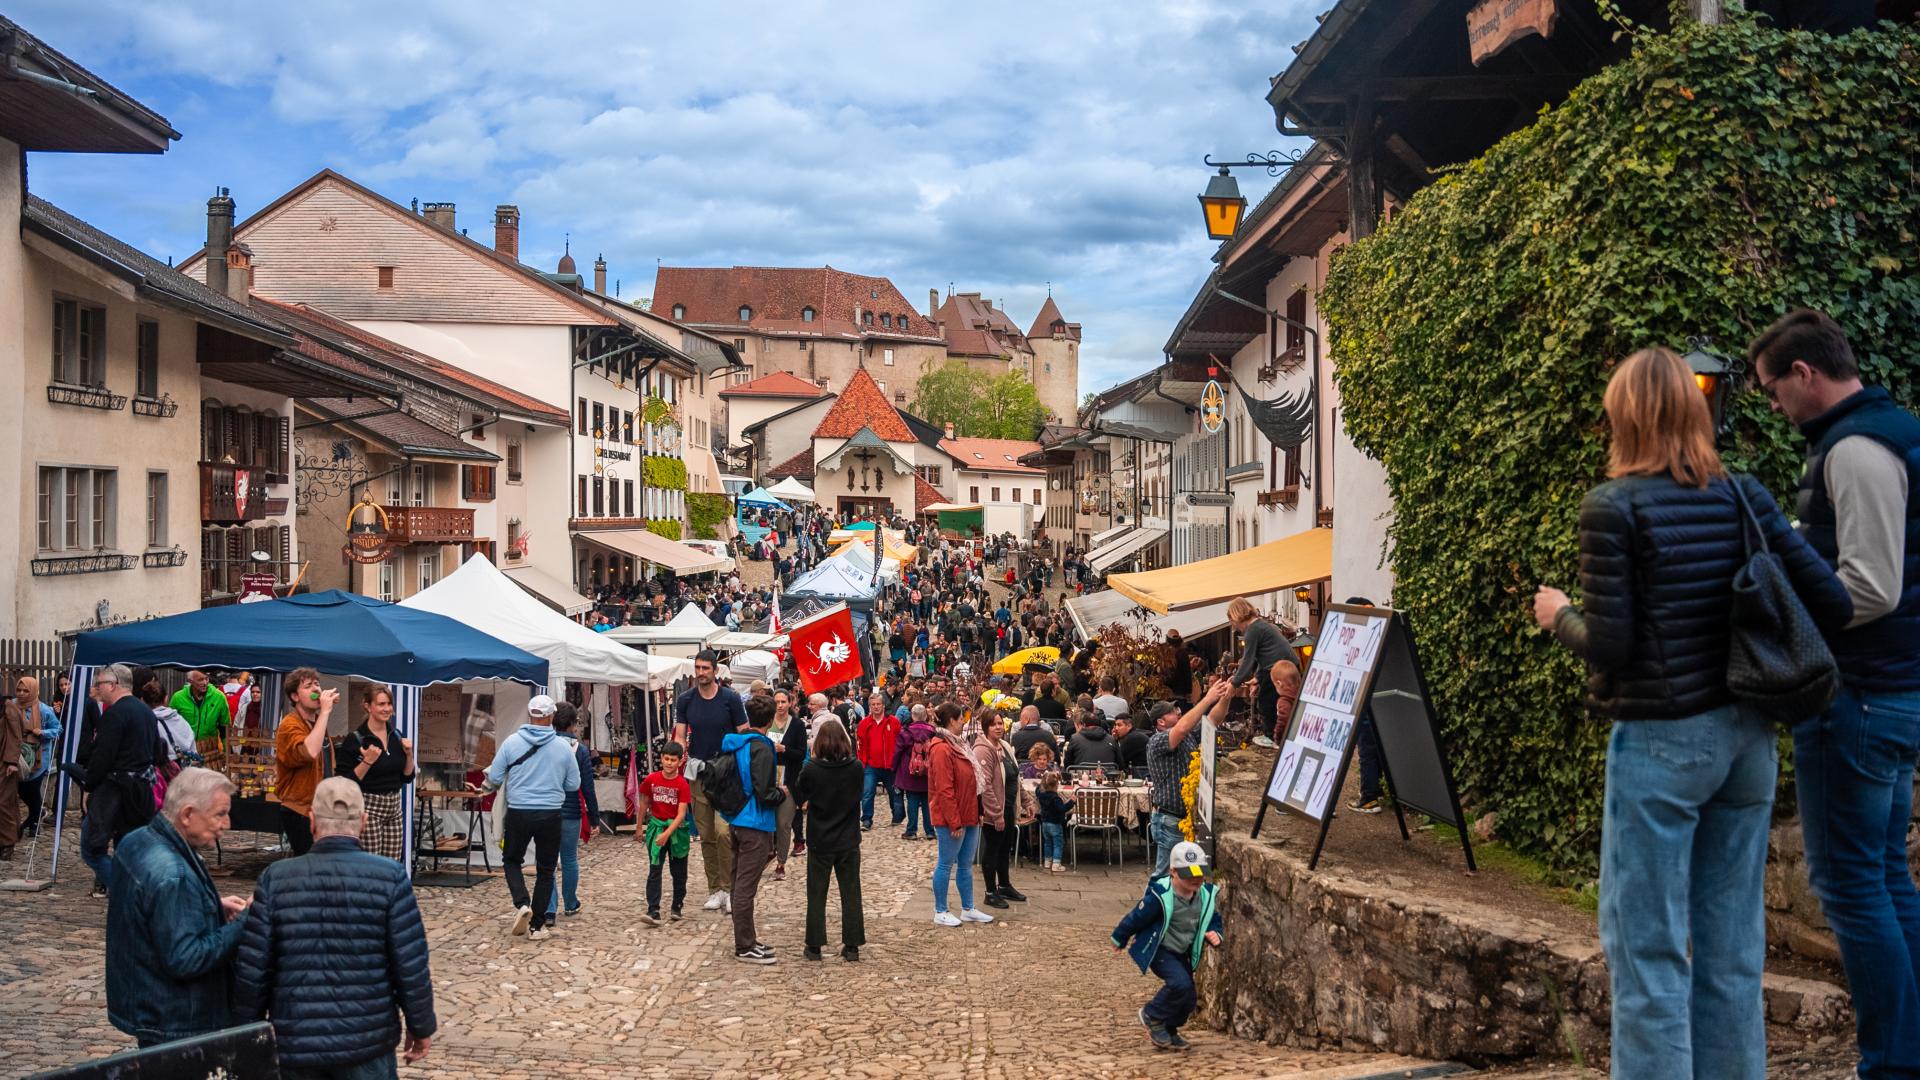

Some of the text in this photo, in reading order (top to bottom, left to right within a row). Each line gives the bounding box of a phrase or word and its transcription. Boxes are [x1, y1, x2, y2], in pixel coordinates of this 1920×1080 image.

[1338, 626, 1356, 646] POP
[1304, 668, 1358, 706] BAR À VIN
[1299, 713, 1352, 753] WINE BAR
